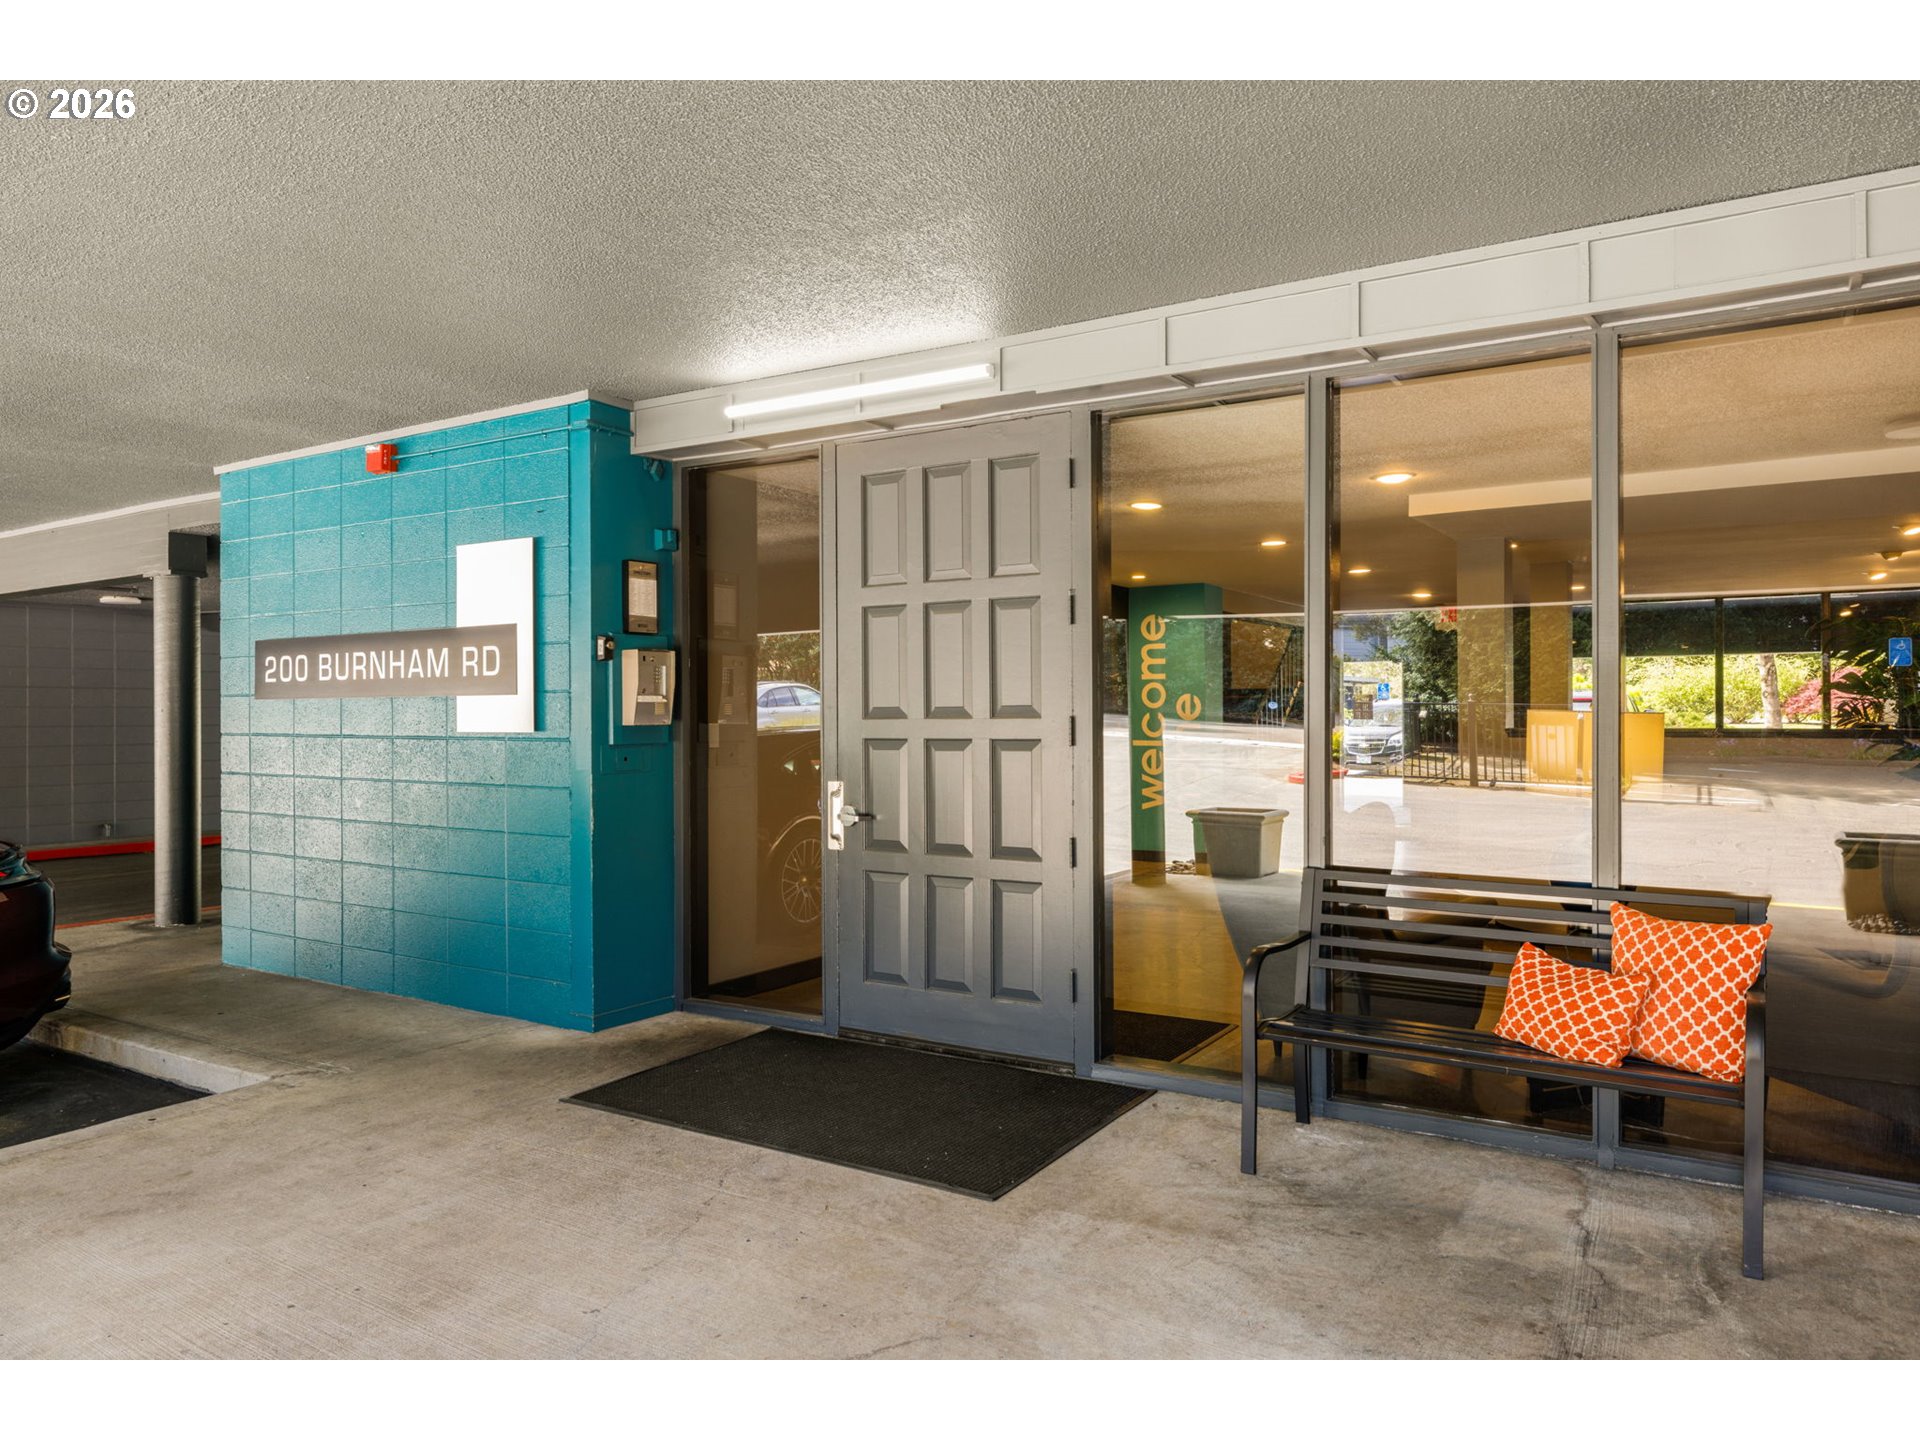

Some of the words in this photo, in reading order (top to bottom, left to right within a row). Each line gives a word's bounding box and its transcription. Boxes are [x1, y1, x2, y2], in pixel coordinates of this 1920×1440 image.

[264, 654, 309, 683] 200
[318, 647, 450, 682] BURNHAM
[462, 645, 501, 677] RD
[1132, 614, 1167, 810] welcome
